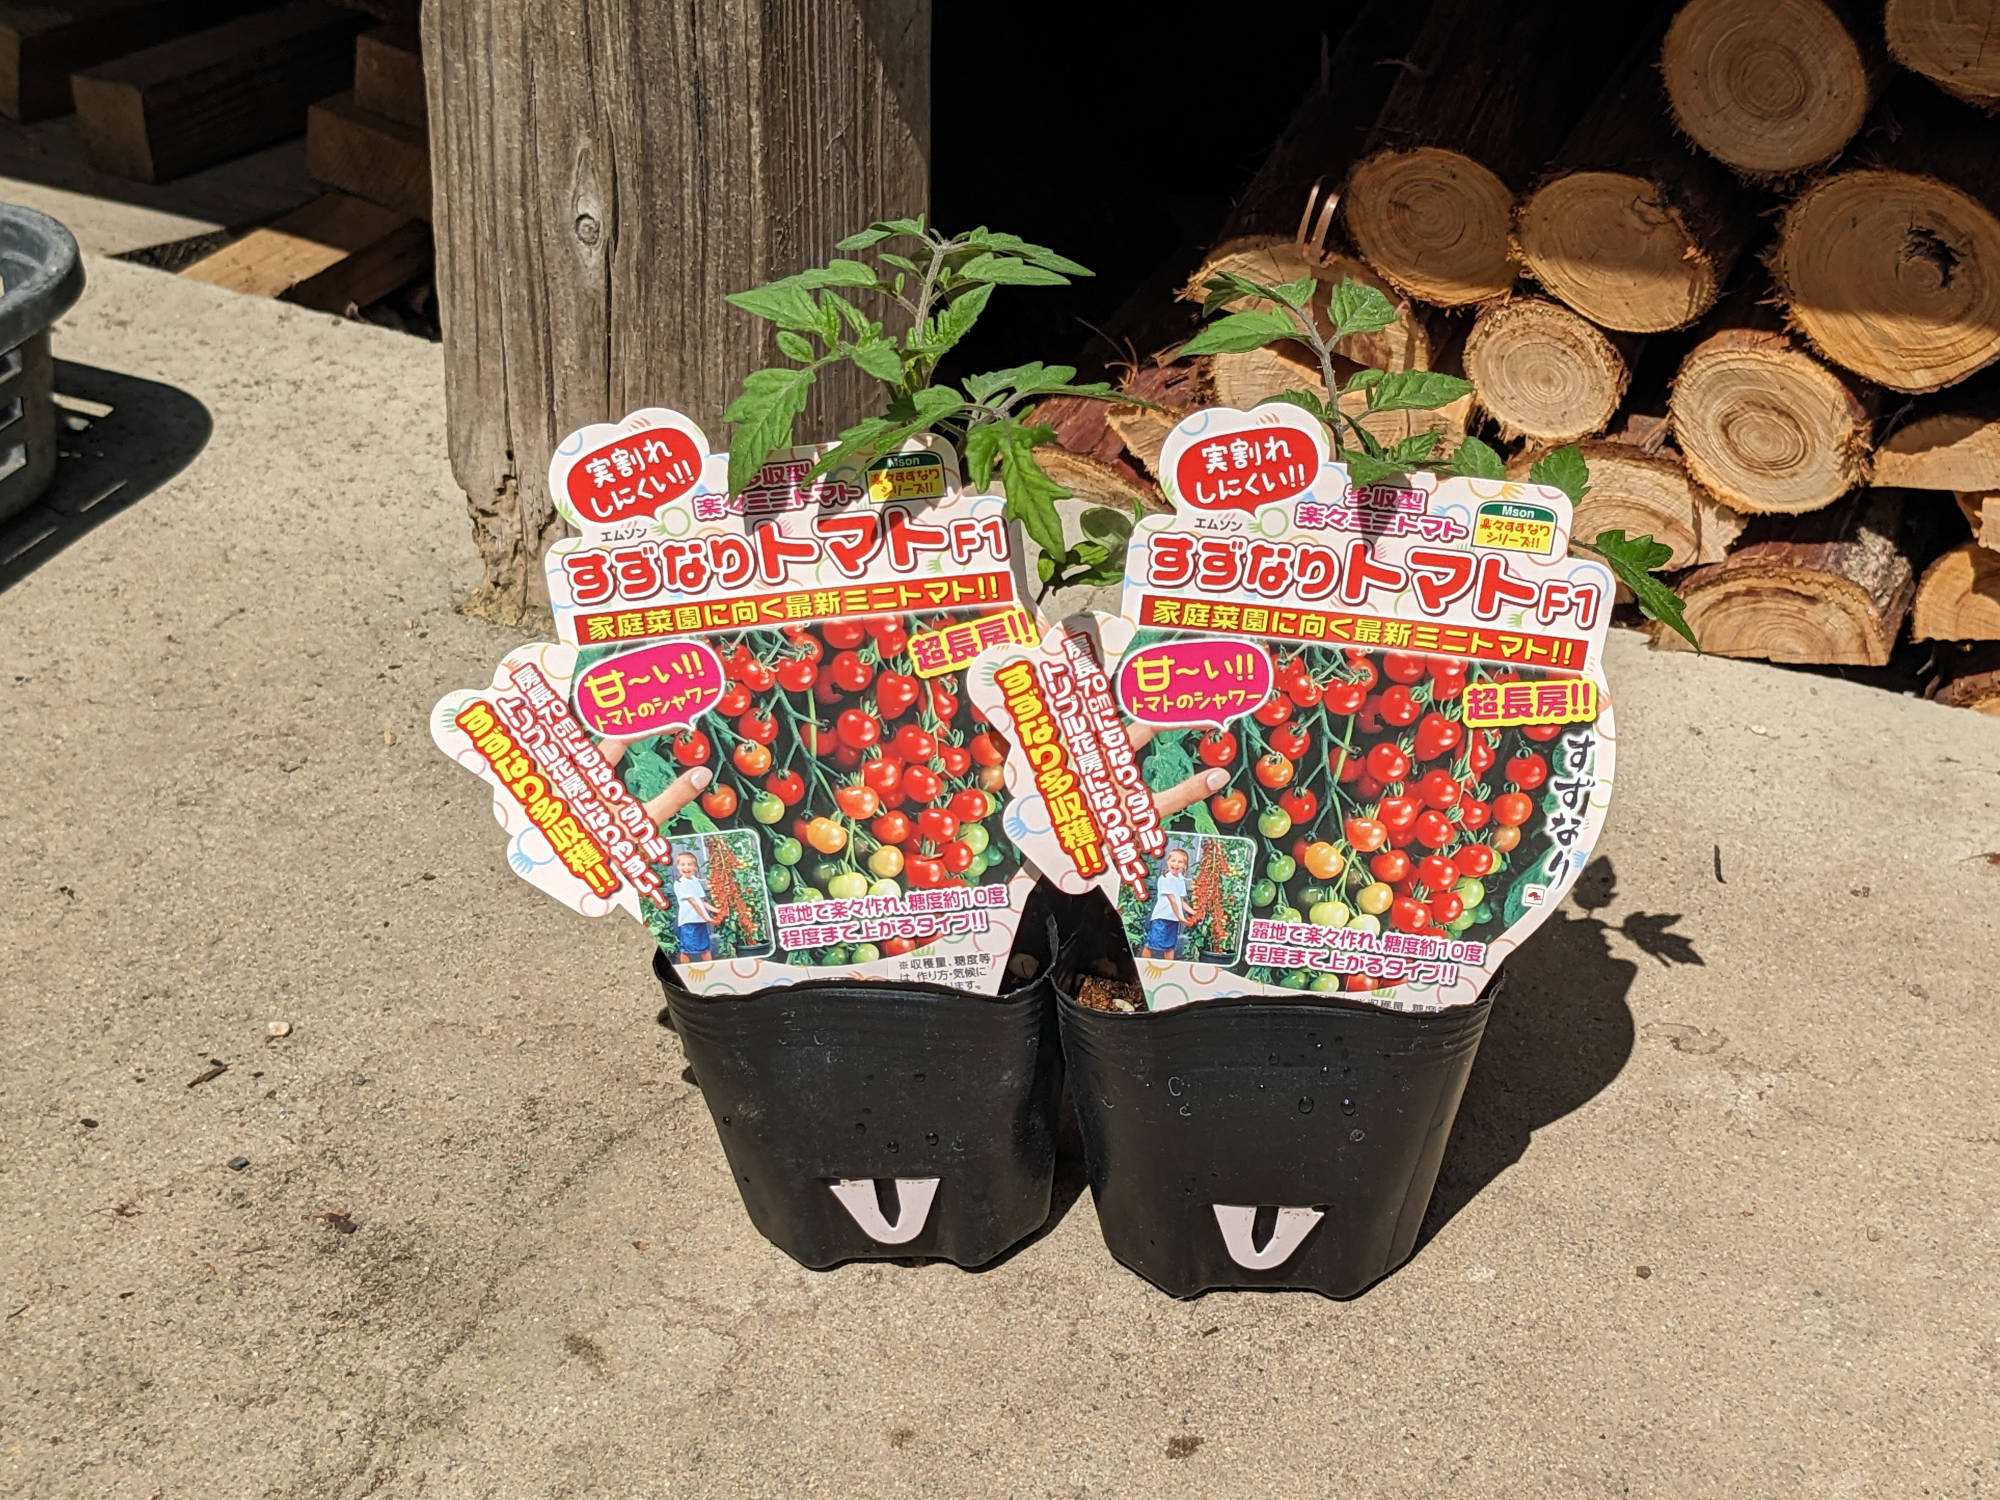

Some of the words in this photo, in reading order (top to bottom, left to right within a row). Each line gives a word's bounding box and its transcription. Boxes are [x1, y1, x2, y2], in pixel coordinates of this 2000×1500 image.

[585, 439, 673, 488] 実割れ
[1202, 436, 1292, 474] 実割れ
[590, 460, 694, 517] しにくい!!
[1196, 463, 1305, 504] しにくい!!
[1346, 485, 1425, 512] 多収型
[1194, 518, 1242, 532] エムソン
[1298, 505, 1466, 539] 楽々ミニトマト
[1501, 505, 1535, 519] Mson
[601, 527, 647, 542] エムソン
[1486, 532, 1540, 549] シリーズ!!
[587, 576, 998, 640] 家庭菜園に向く最新ミニトマト!!
[1152, 600, 1573, 666] 家庭菜園に向く最新ミニトマト!!
[594, 687, 718, 732] トマトのシャワー
[1131, 690, 1262, 715] トマトのシャワー
[1467, 684, 1590, 721] 超長房!!
[997, 662, 1103, 875] すずなり多収穫!!
[1548, 734, 1596, 889] すずなり
[781, 912, 988, 948] 程度まで上がるタイプ!!
[1248, 945, 1457, 985] 程度まで上がるタイプ!!
